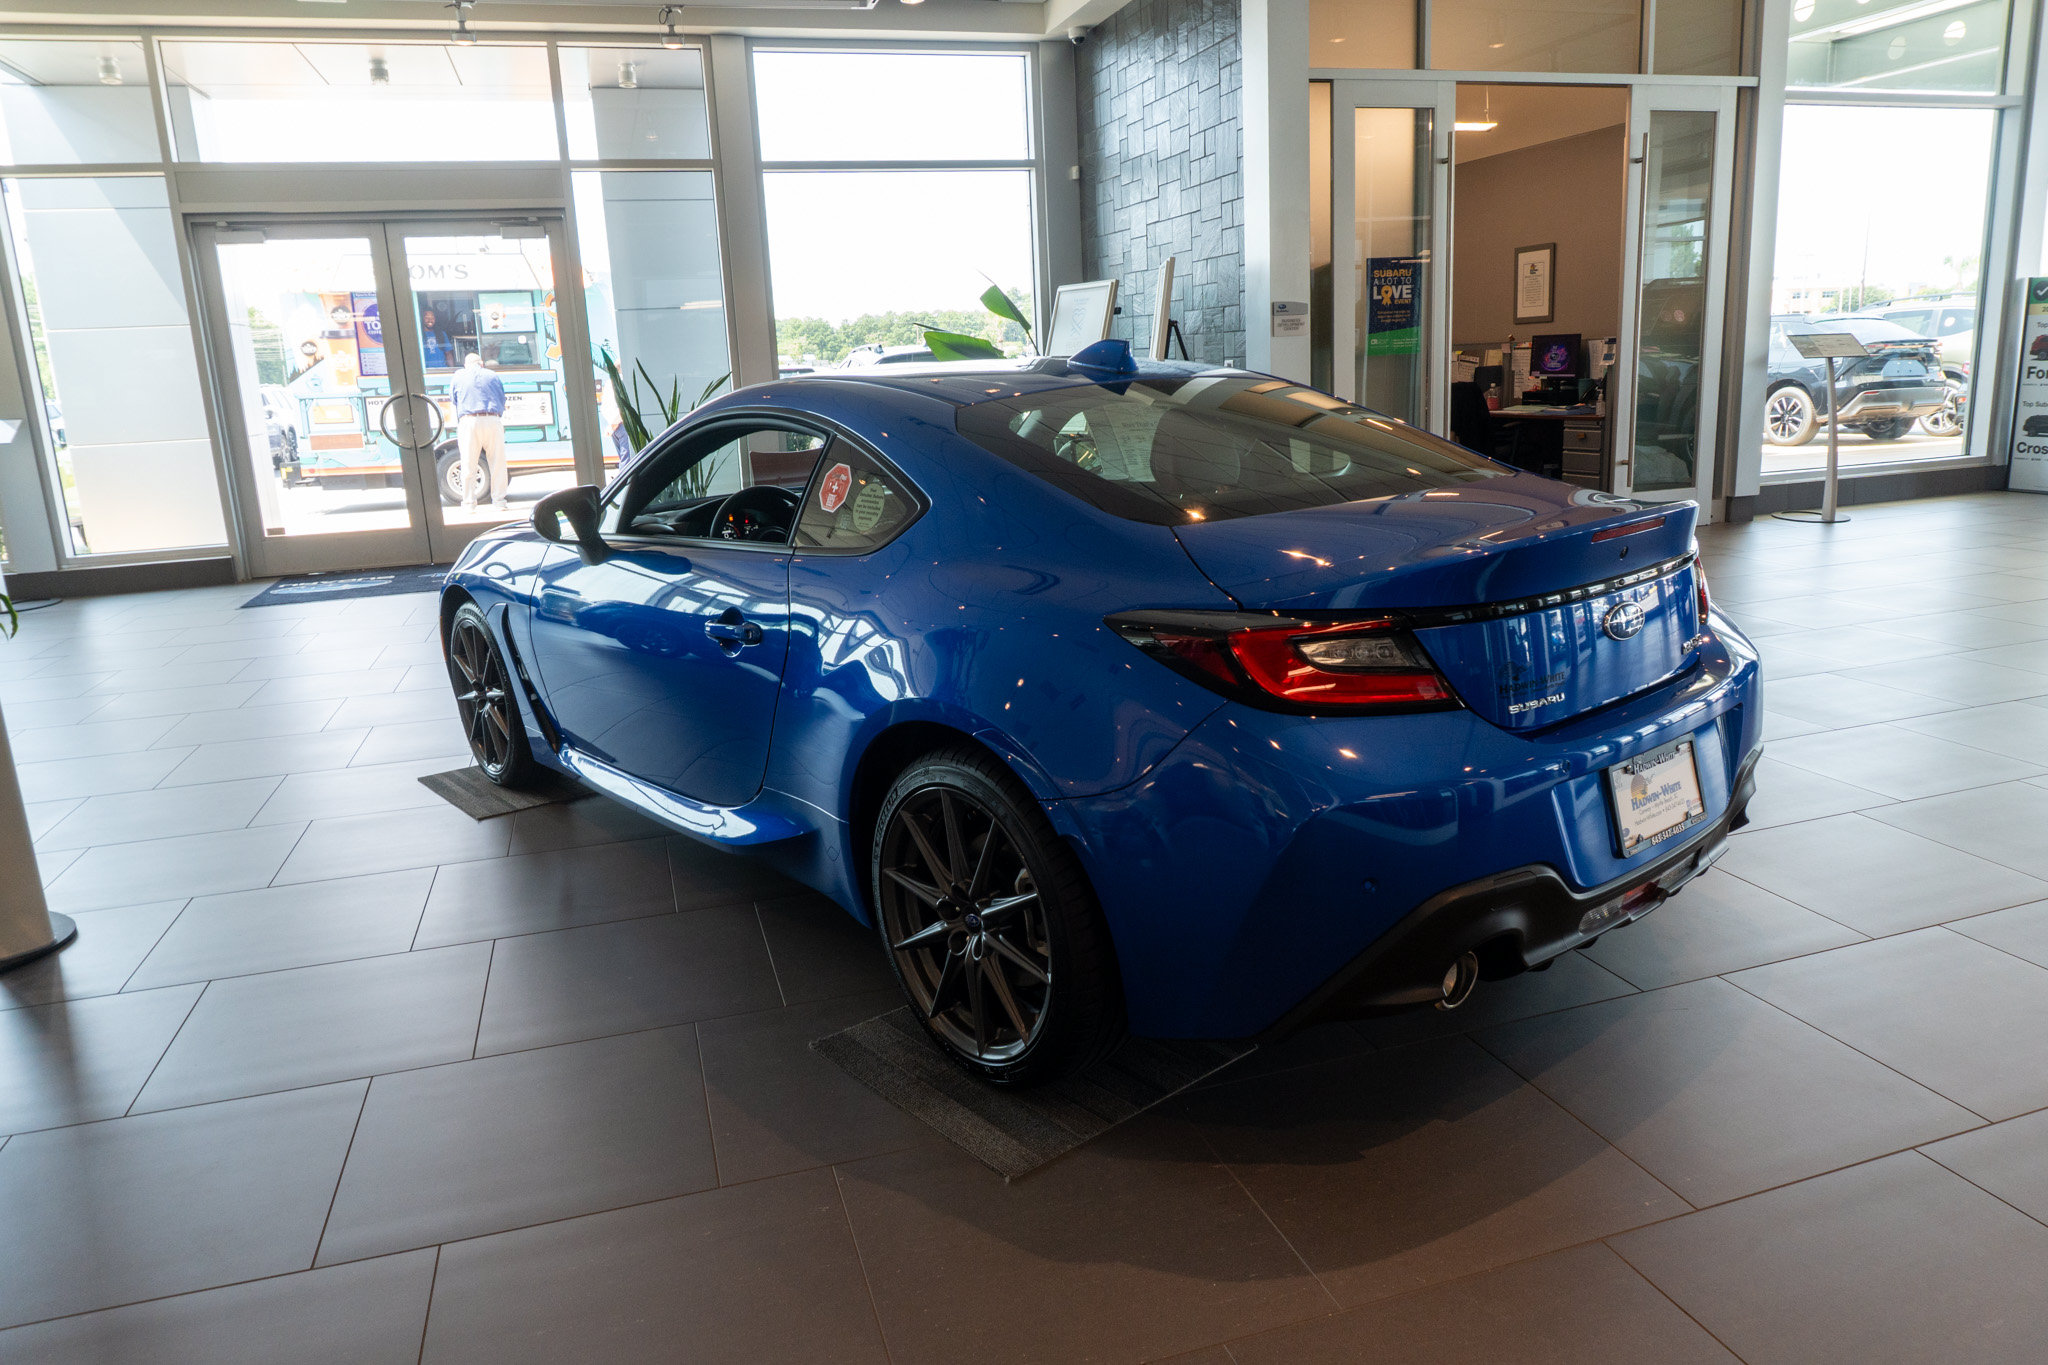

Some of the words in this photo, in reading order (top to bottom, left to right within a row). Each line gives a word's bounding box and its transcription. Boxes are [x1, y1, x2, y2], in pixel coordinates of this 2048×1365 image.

[409, 264, 469, 280] OM'S
[1373, 269, 1412, 278] SUBARU
[1401, 277, 1412, 285] TO
[1373, 284, 1412, 301] LOVE
[2016, 442, 2048, 455] Cros
[1508, 692, 1566, 715] SUBARU
